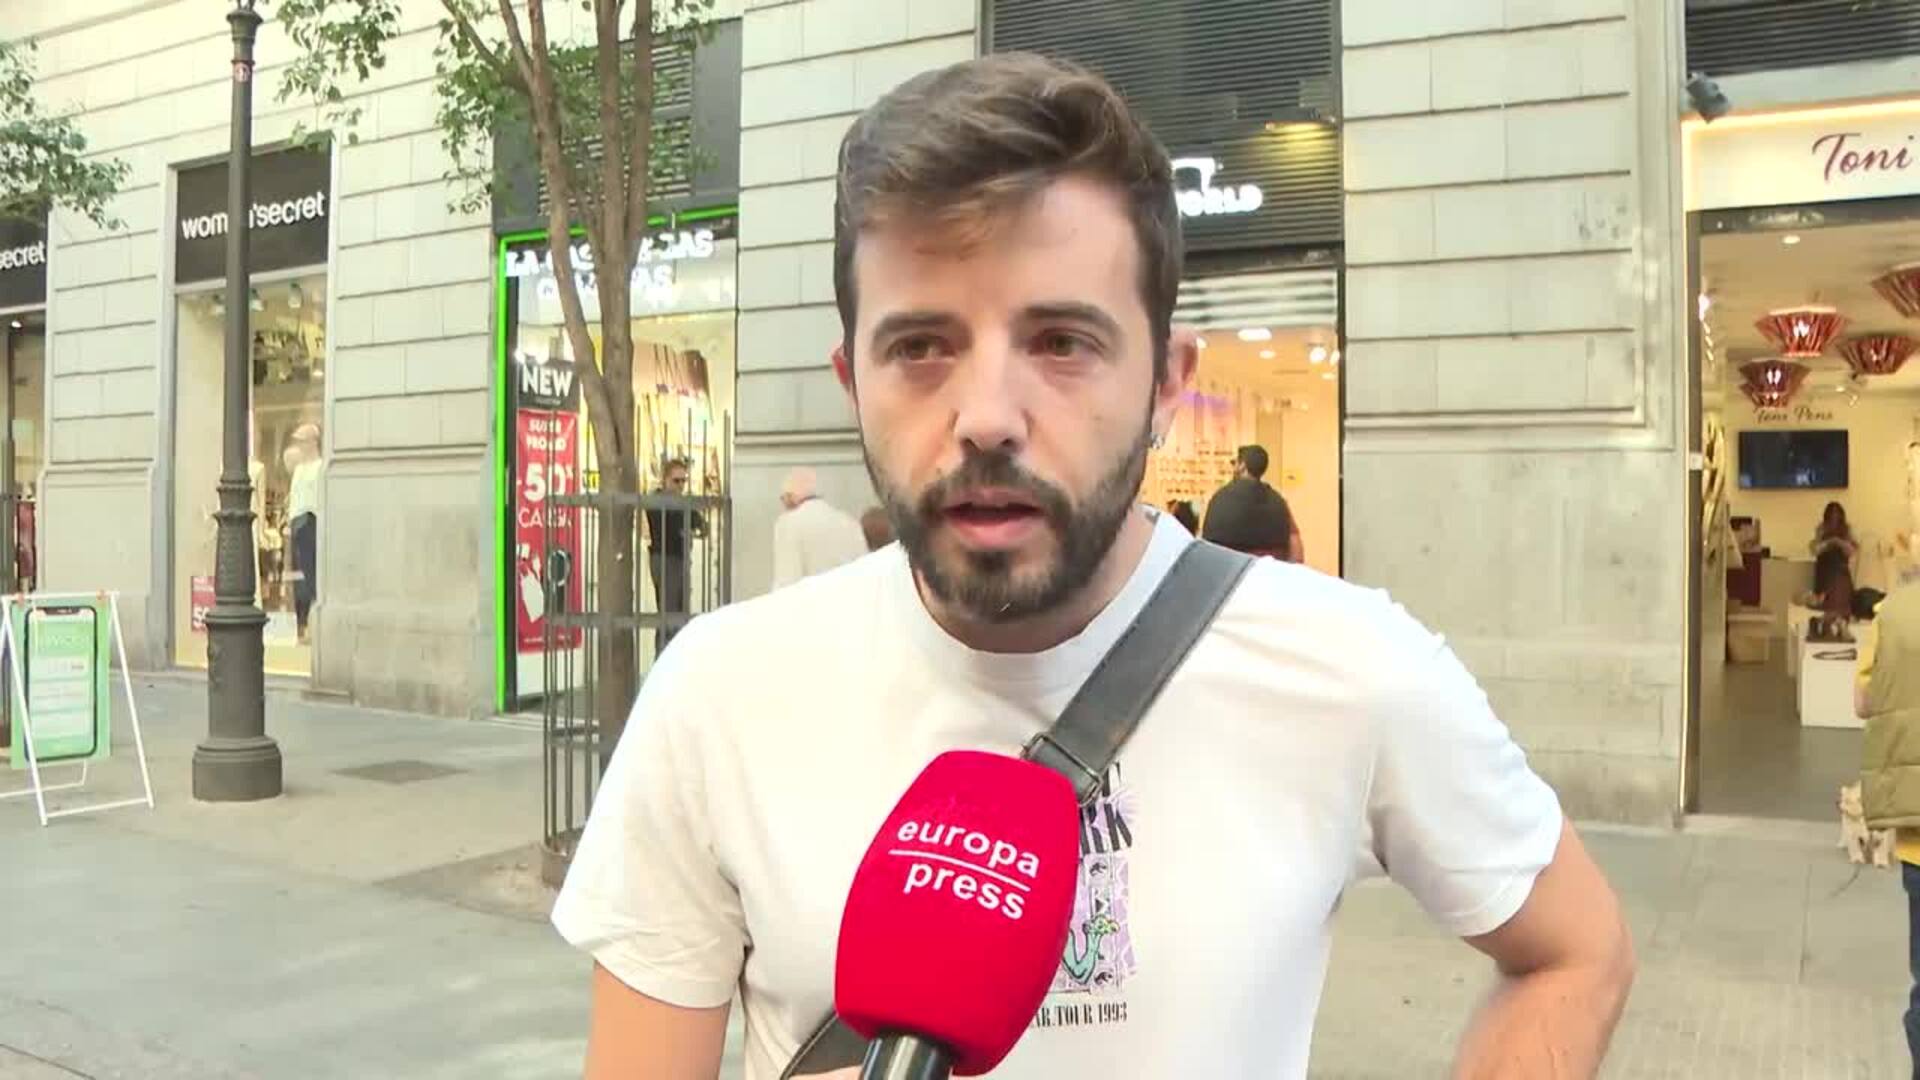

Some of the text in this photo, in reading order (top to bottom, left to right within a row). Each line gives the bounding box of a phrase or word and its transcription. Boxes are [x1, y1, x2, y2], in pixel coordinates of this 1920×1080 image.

[1811, 132, 1915, 183] Toni
[0, 240, 46, 269] ecret
[522, 363, 573, 398] NEW
[897, 820, 1041, 879] europa
[902, 862, 1026, 921] press
